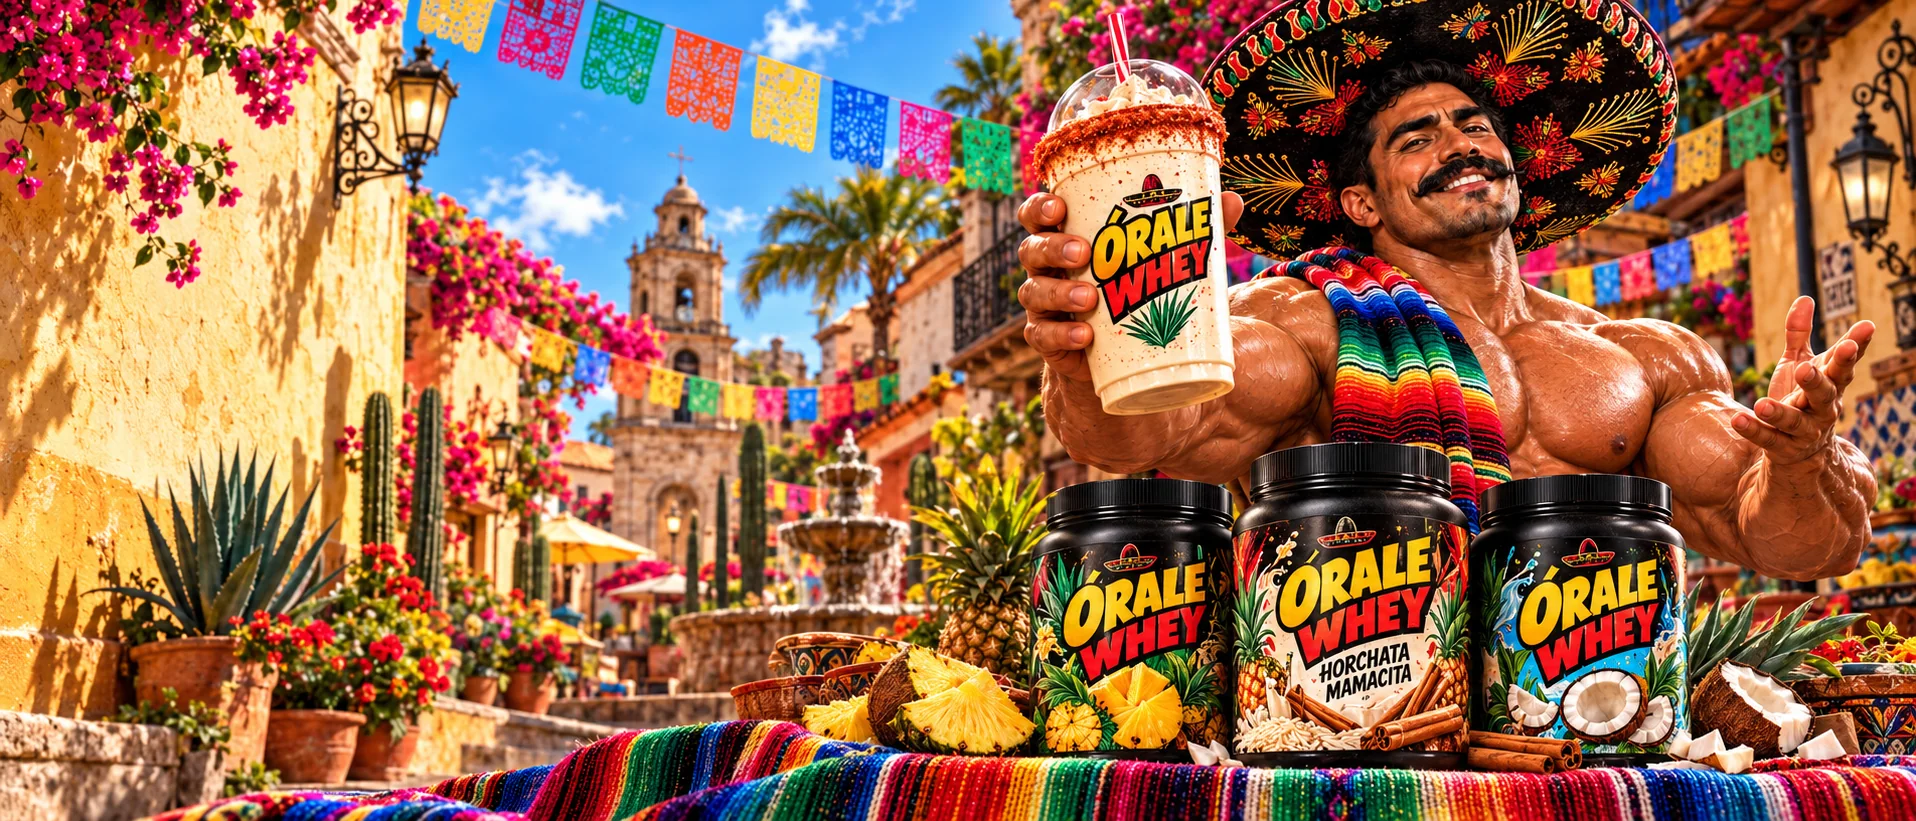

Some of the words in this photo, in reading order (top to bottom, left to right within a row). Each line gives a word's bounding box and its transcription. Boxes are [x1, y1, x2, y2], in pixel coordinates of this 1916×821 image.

[1092, 199, 1211, 281] ÓRALE
[1103, 239, 1210, 318] WHEY
[1063, 562, 1206, 648] ÓRALE
[1278, 535, 1431, 629] ÓRALE
[1519, 558, 1659, 646] ÓRALE
[1079, 604, 1207, 682] WHEY
[1297, 585, 1431, 665] WHEY
[1318, 642, 1410, 684] HORCHATA
[1536, 602, 1660, 682] WHEY
[1325, 663, 1412, 703] MAMACITA
